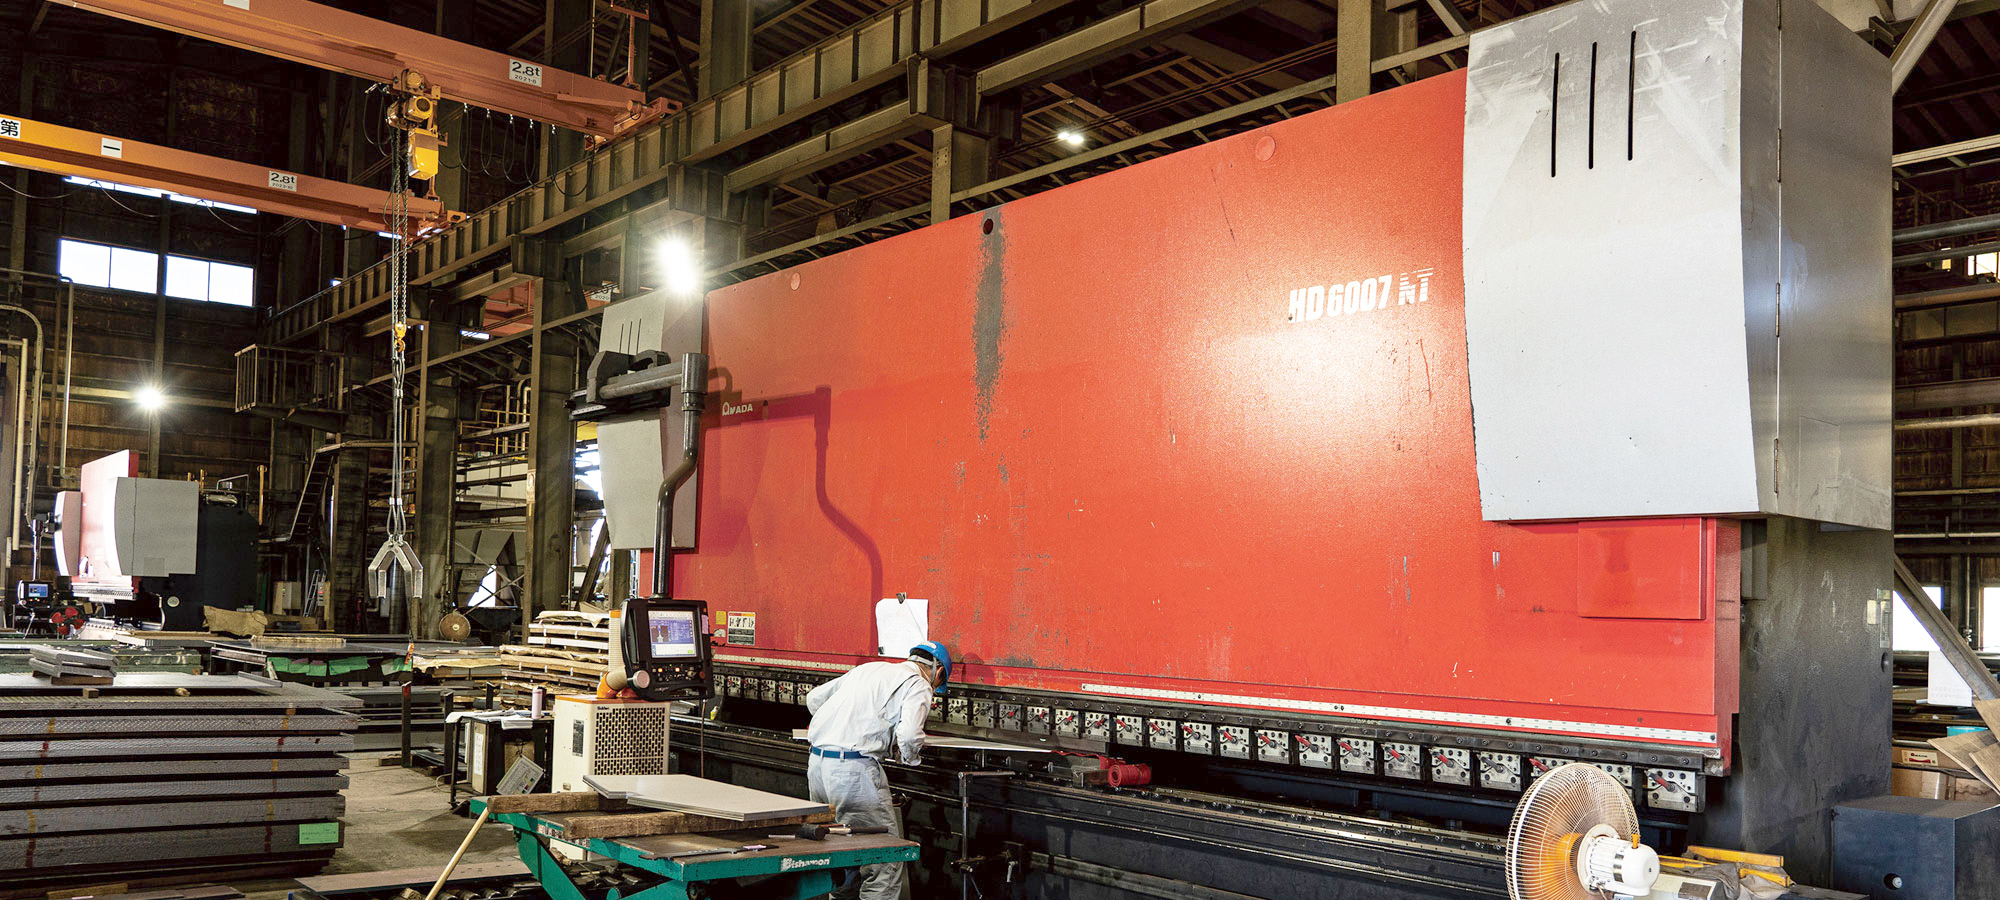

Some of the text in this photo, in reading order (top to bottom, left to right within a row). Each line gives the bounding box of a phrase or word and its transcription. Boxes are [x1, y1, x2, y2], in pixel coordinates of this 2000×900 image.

[511, 61, 541, 77] 2.8t
[0, 119, 19, 137] 第
[271, 172, 295, 184] 2.8t
[1398, 267, 1434, 306] NT
[781, 857, 830, 871] Bishamon
